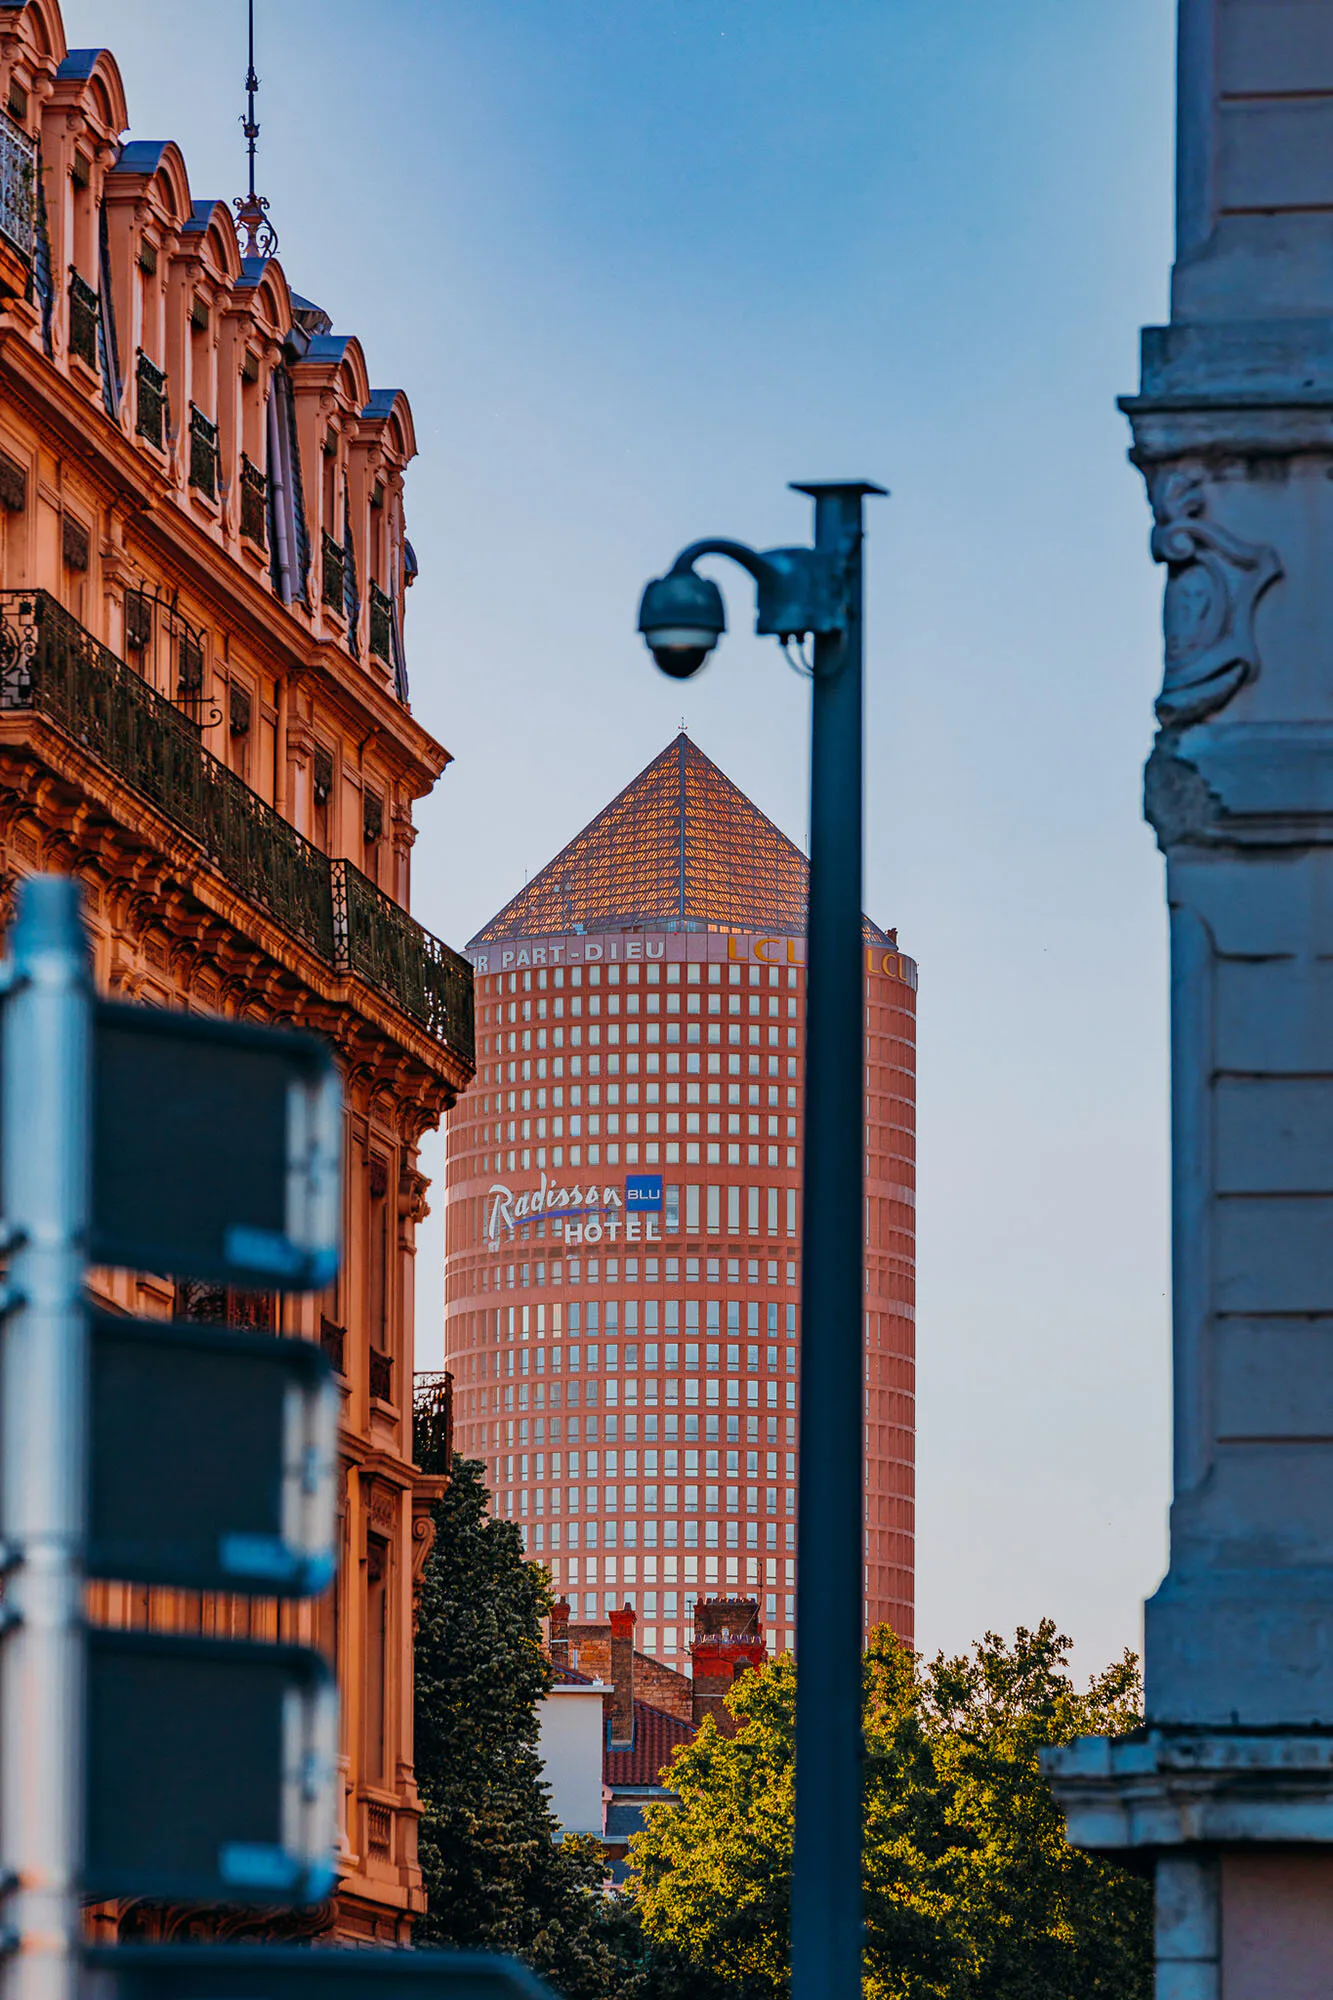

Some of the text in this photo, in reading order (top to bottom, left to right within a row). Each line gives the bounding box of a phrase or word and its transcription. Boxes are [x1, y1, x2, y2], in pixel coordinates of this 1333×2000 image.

[502, 942, 664, 968] PART-DIEU
[729, 937, 806, 965] LCL
[867, 949, 907, 982] LCL
[488, 1171, 660, 1240] Radisson BLU
[564, 1221, 662, 1244] HOTEL
